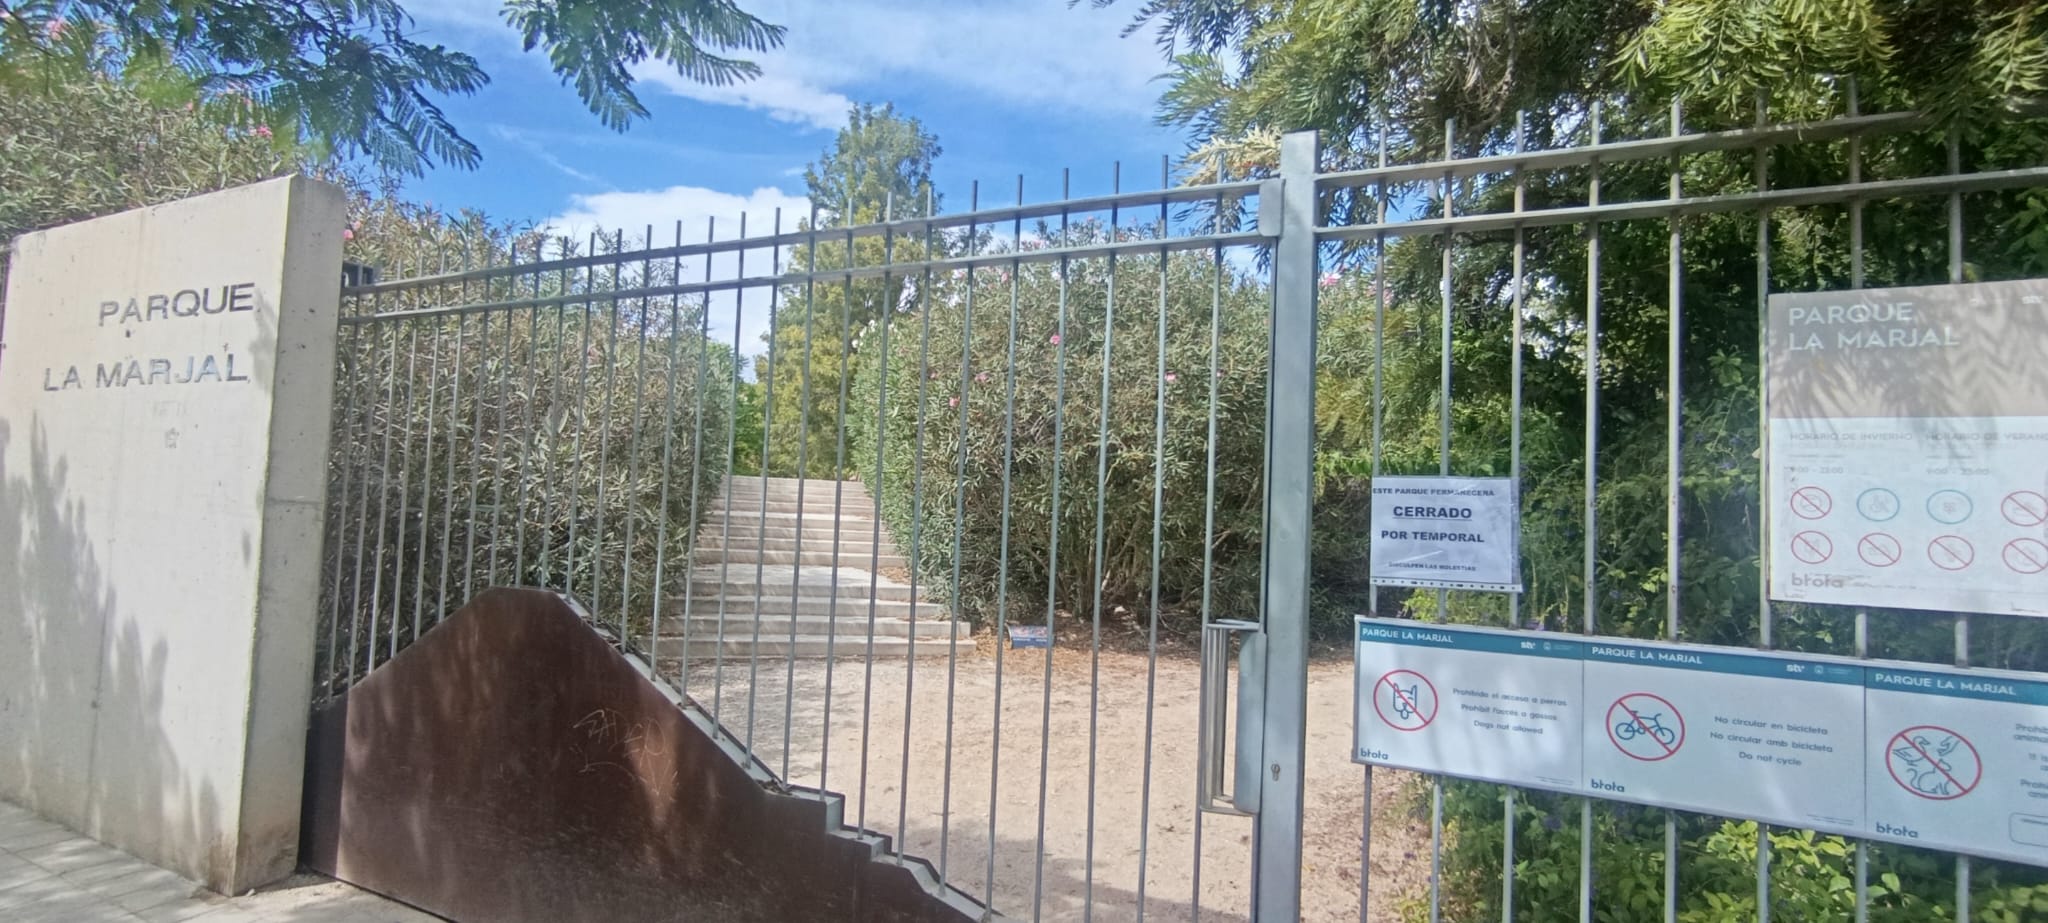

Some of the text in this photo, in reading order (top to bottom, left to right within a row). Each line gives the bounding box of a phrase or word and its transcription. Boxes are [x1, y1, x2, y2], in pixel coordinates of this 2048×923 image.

[99, 282, 255, 327] PARQUE
[1788, 302, 1914, 326] PARQUE
[1788, 325, 1961, 352] LA MARJAL
[44, 354, 248, 392] LA MARJAL
[1372, 487, 1393, 495] ESTE
[1394, 488, 1428, 496] PARQUE
[1393, 506, 1472, 519] CERRADO
[1381, 530, 1485, 543] POR TEMPORAL
[1362, 628, 1454, 643] PARQUE LA MARJAL
[1592, 646, 1703, 665] PARQUE LA MARJAL
[1875, 673, 2017, 696] PARQUE LA MARJAL
[1474, 720, 1494, 729] Dogs
[1714, 716, 1728, 724] No
[1732, 718, 1767, 728] circular
[1787, 724, 1828, 735] bicicleta
[1710, 731, 1833, 753] No circular amb bicicleta
[1738, 751, 1802, 766] Do not cycle
